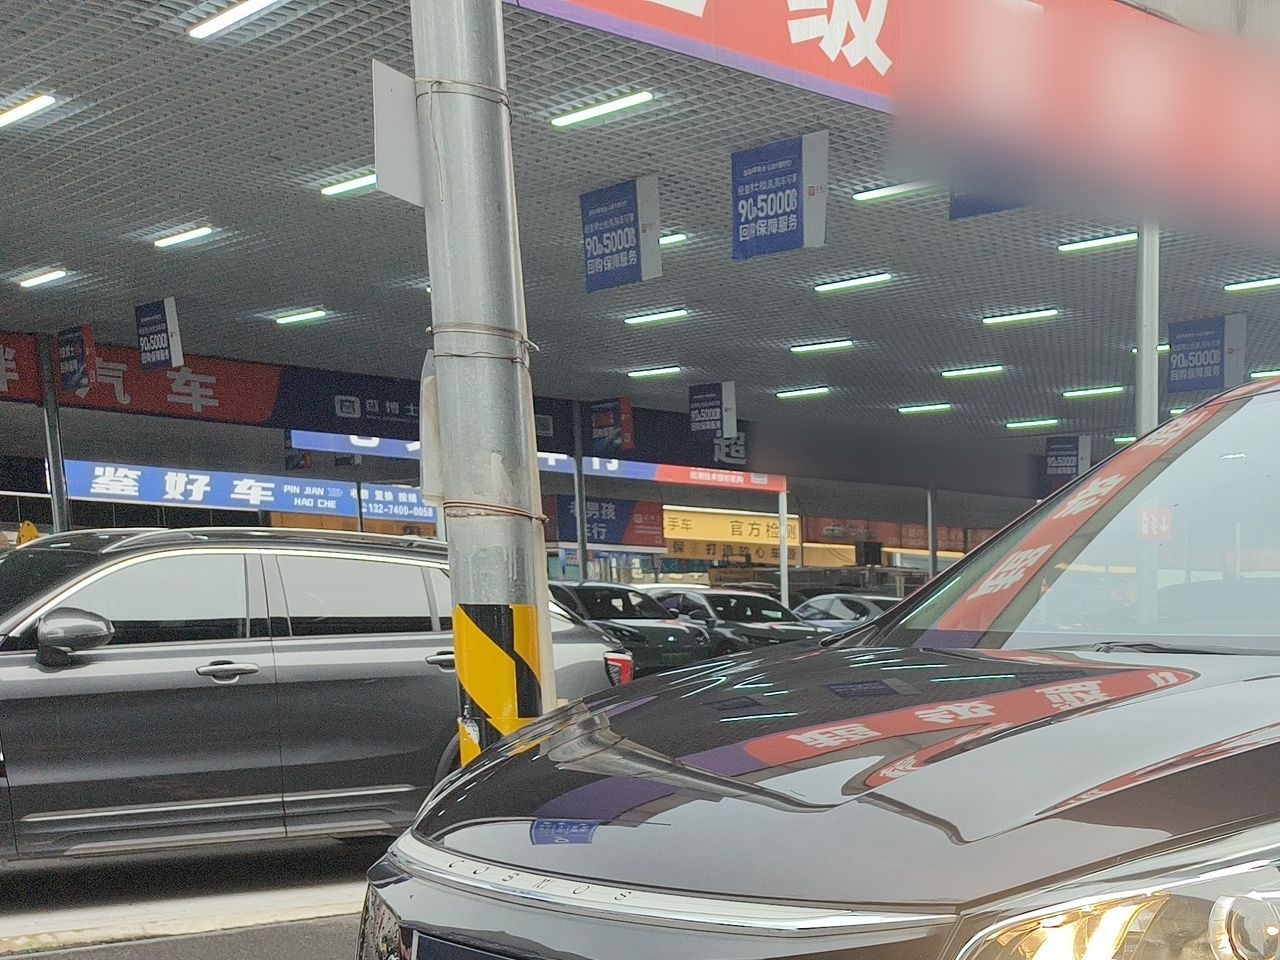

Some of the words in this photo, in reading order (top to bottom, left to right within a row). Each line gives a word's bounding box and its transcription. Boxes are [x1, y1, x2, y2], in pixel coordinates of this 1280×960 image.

[89, 466, 275, 505] 鉴好车
[284, 484, 300, 495] PIN
[304, 486, 325, 496] JIAN
[317, 499, 337, 509] CHE
